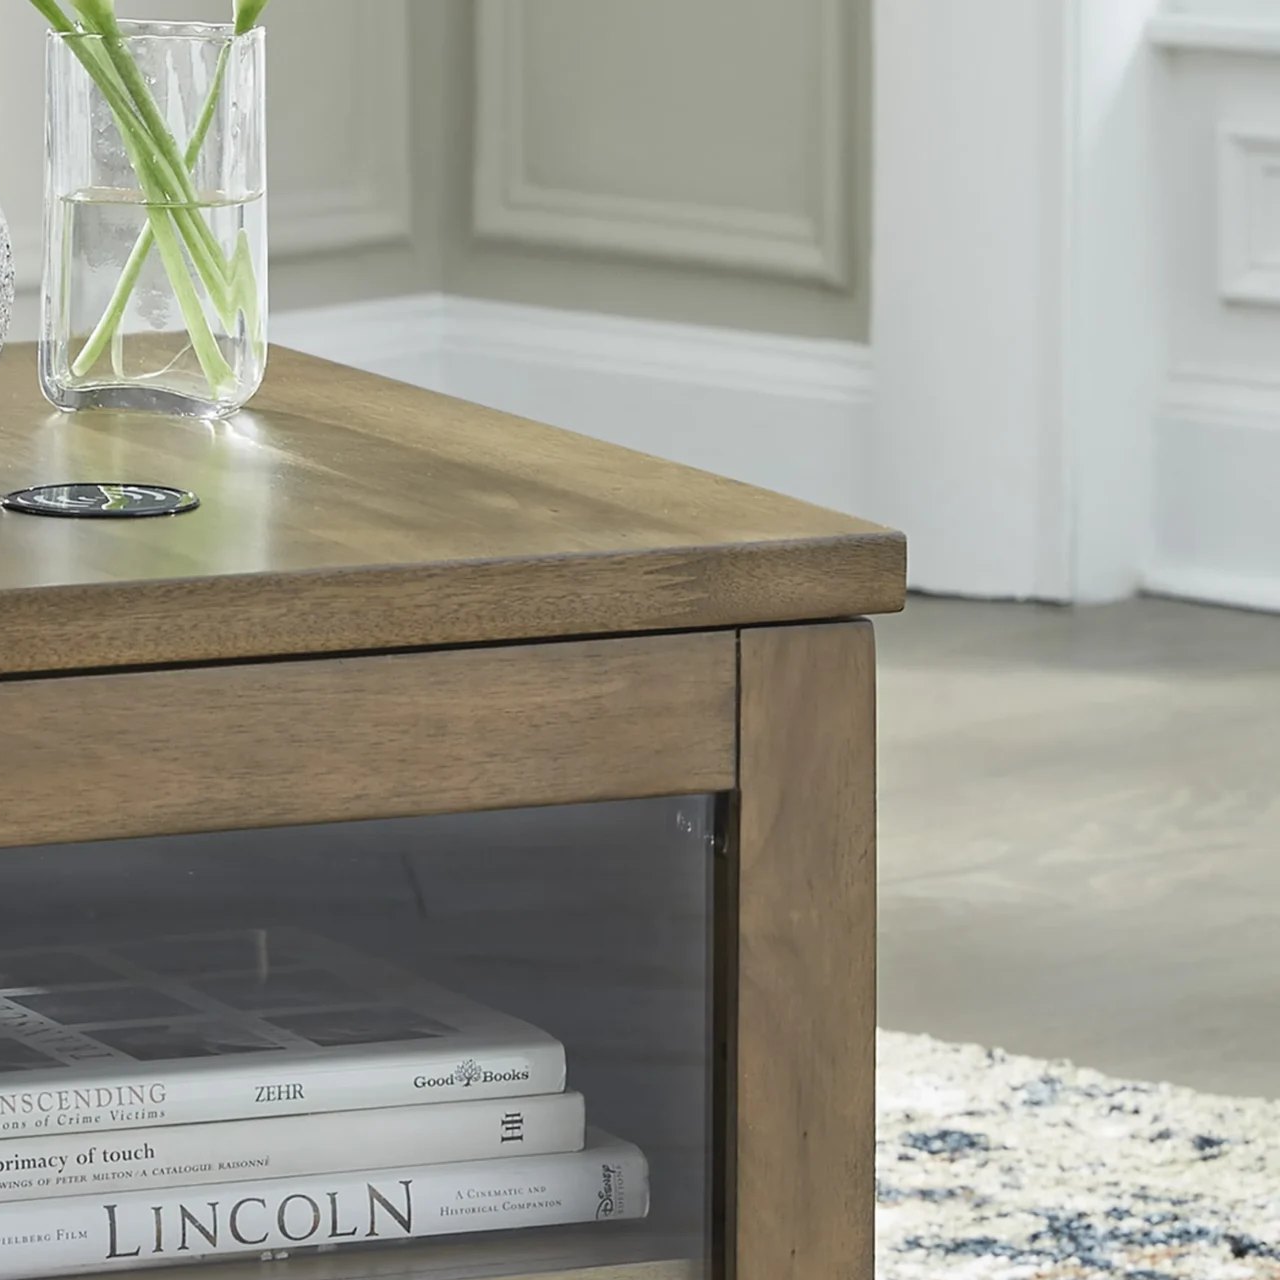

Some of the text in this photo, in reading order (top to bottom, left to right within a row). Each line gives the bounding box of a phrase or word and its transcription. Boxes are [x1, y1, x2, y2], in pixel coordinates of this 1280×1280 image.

[413, 1069, 529, 1089] Good Books
[255, 1083, 305, 1102] ZEHR
[35, 1115, 50, 1127] of
[57, 1113, 101, 1126] Crime
[110, 1109, 166, 1121] Victims
[76, 1147, 96, 1165] of
[103, 1143, 155, 1163] touch
[37, 1178, 51, 1187] OF
[55, 1174, 87, 1185] PETER
[152, 1163, 213, 1176] CATALOGUE
[455, 1190, 464, 1200] A
[103, 1180, 413, 1259] LINCOLN
